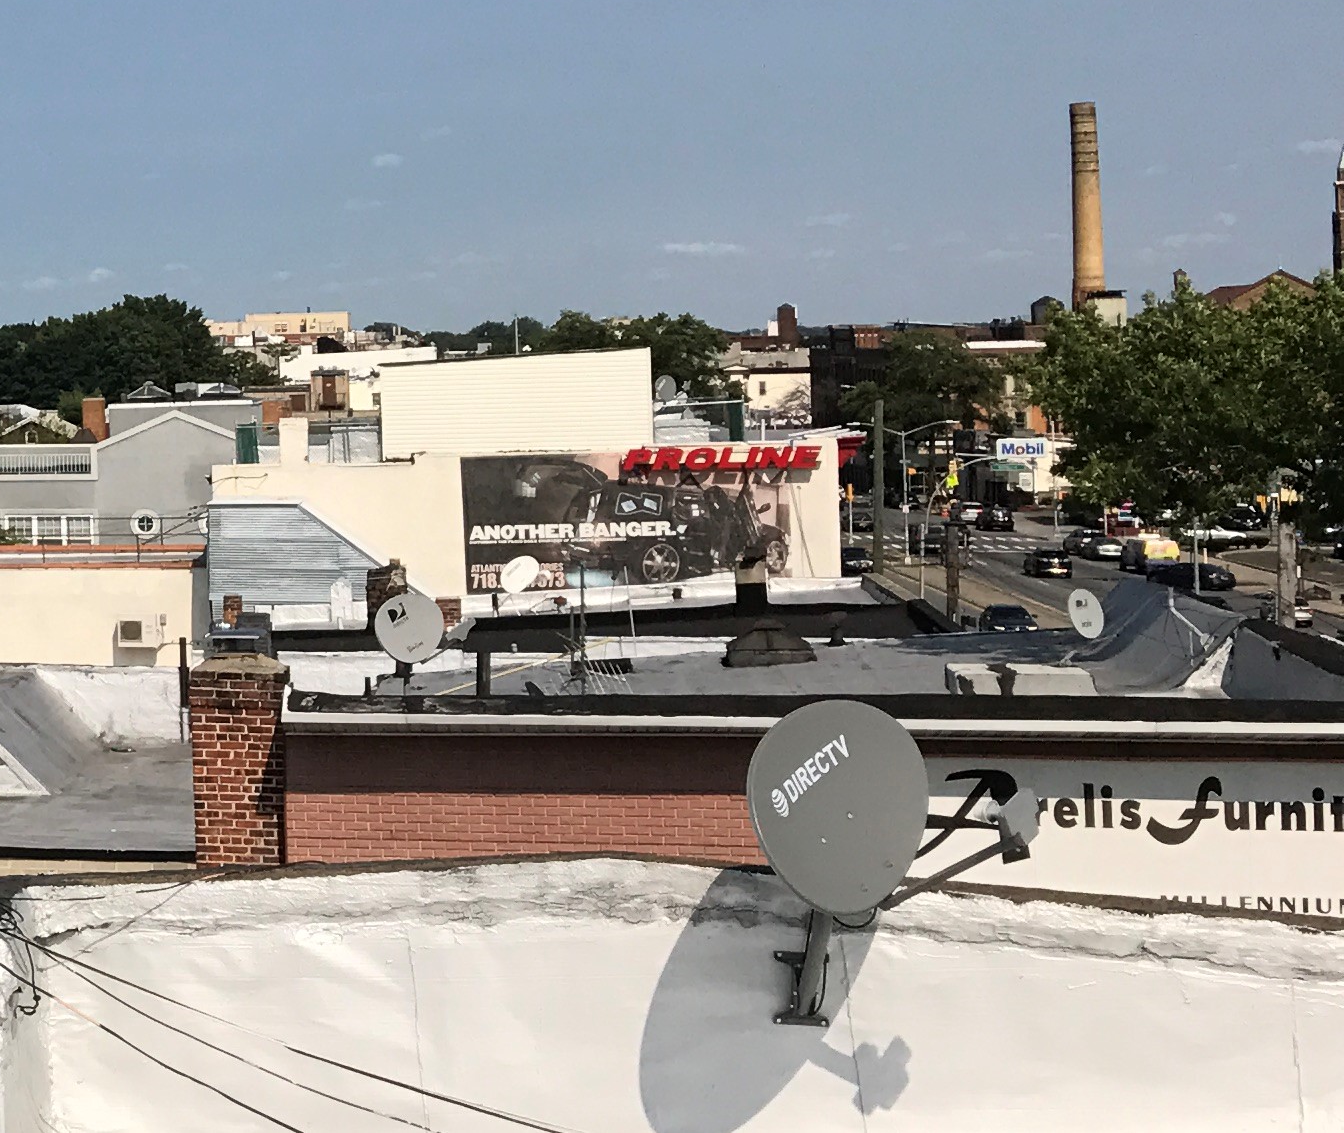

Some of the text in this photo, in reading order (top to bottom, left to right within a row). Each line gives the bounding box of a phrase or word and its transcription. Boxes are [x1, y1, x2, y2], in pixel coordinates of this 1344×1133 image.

[622, 446, 822, 471] PROLINE
[1001, 443, 1044, 455] Mobil
[469, 521, 677, 541] ANOTHER BANGER.
[471, 564, 508, 573] ATLANTI
[783, 734, 850, 803] DIRECTV
